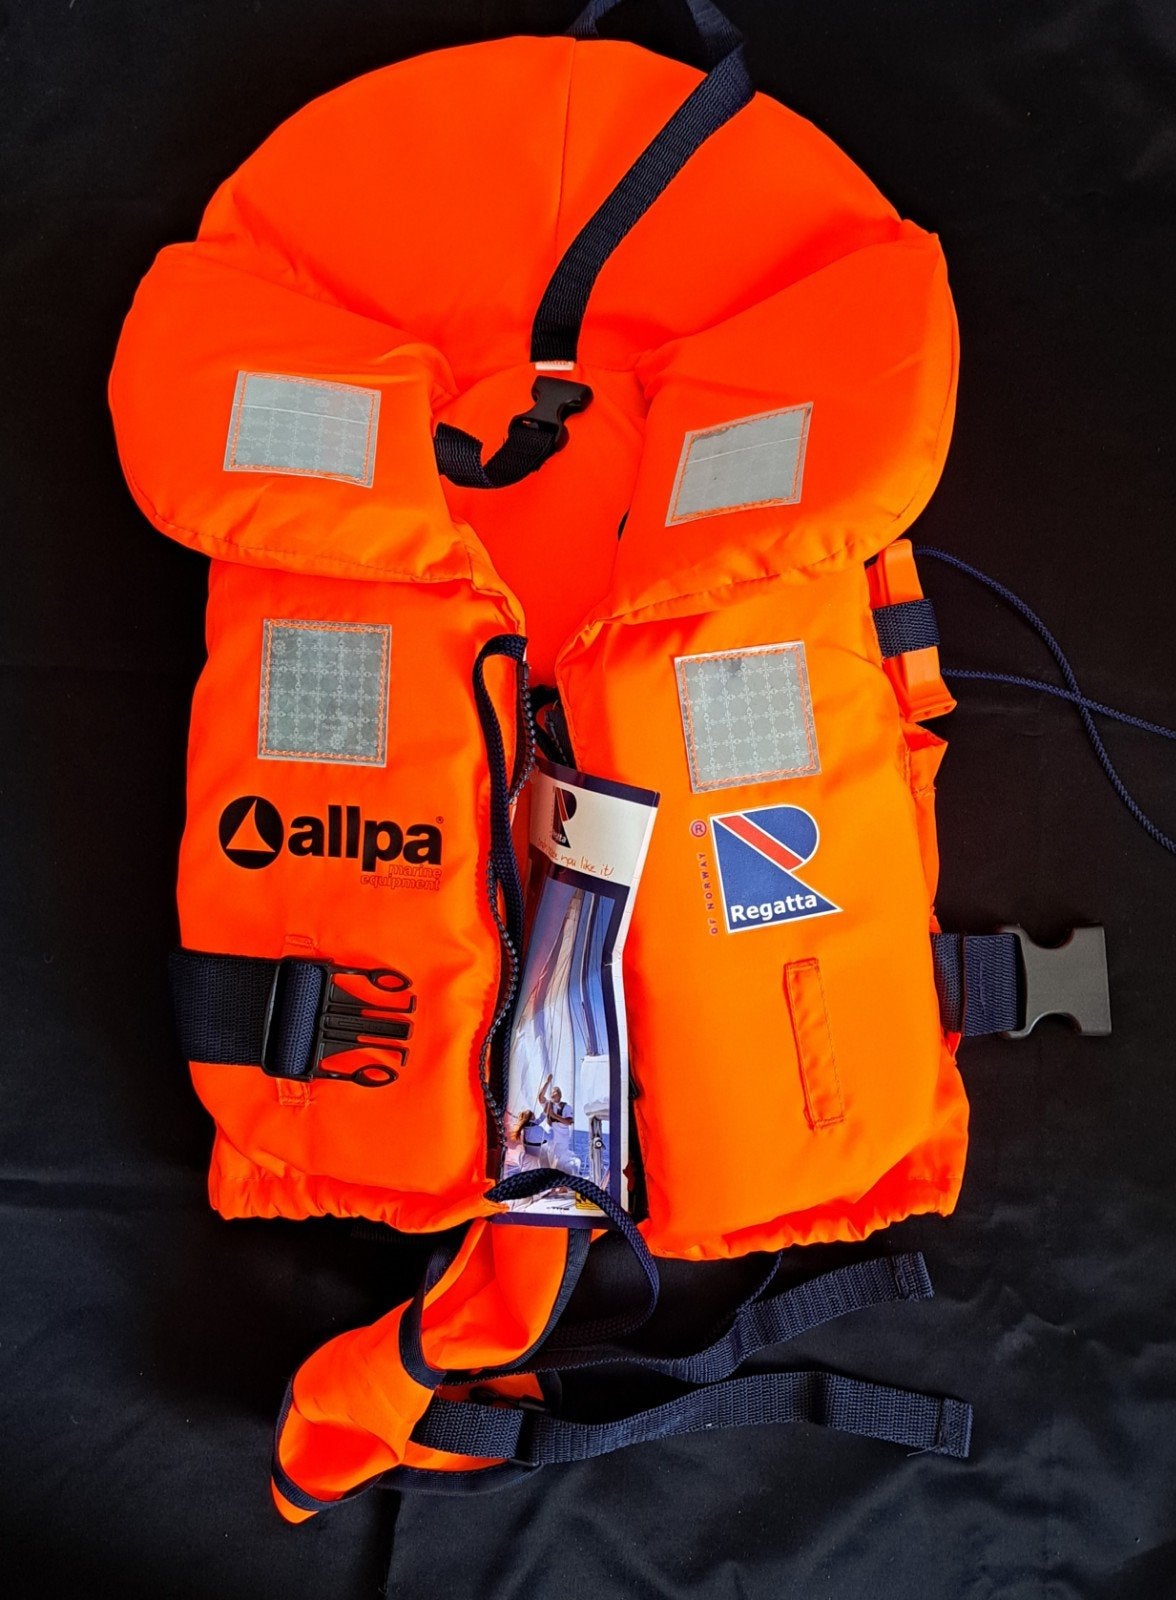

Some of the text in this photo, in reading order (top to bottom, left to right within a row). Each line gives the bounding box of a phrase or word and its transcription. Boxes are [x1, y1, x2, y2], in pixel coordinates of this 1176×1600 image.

[288, 804, 443, 872] allpa
[389, 863, 443, 879] marine
[580, 856, 597, 873] like
[360, 872, 441, 891] equipment
[698, 853, 719, 935] OF NORWAY
[730, 894, 818, 923] Regatta
